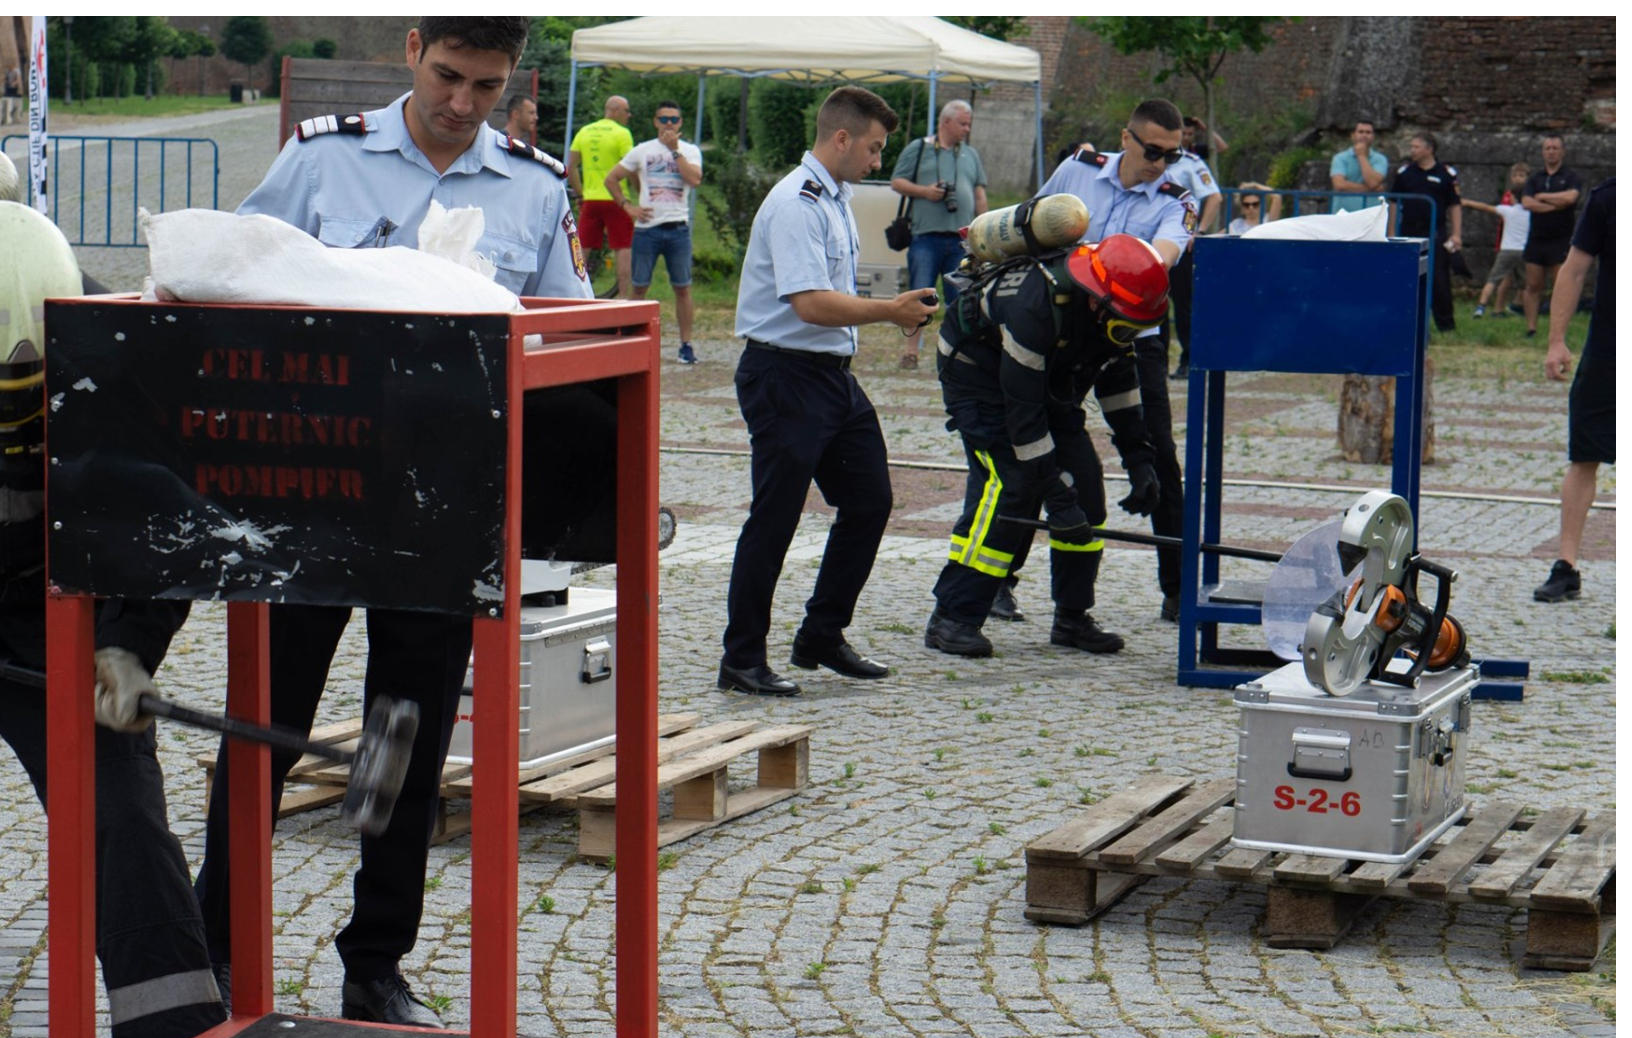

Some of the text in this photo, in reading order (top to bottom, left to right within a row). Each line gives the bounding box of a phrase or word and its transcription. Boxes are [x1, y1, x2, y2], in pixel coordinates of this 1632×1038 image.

[279, 351, 350, 386] MAI
[182, 407, 370, 447] PUTERNIC
[1273, 785, 1362, 817] S-2-6
